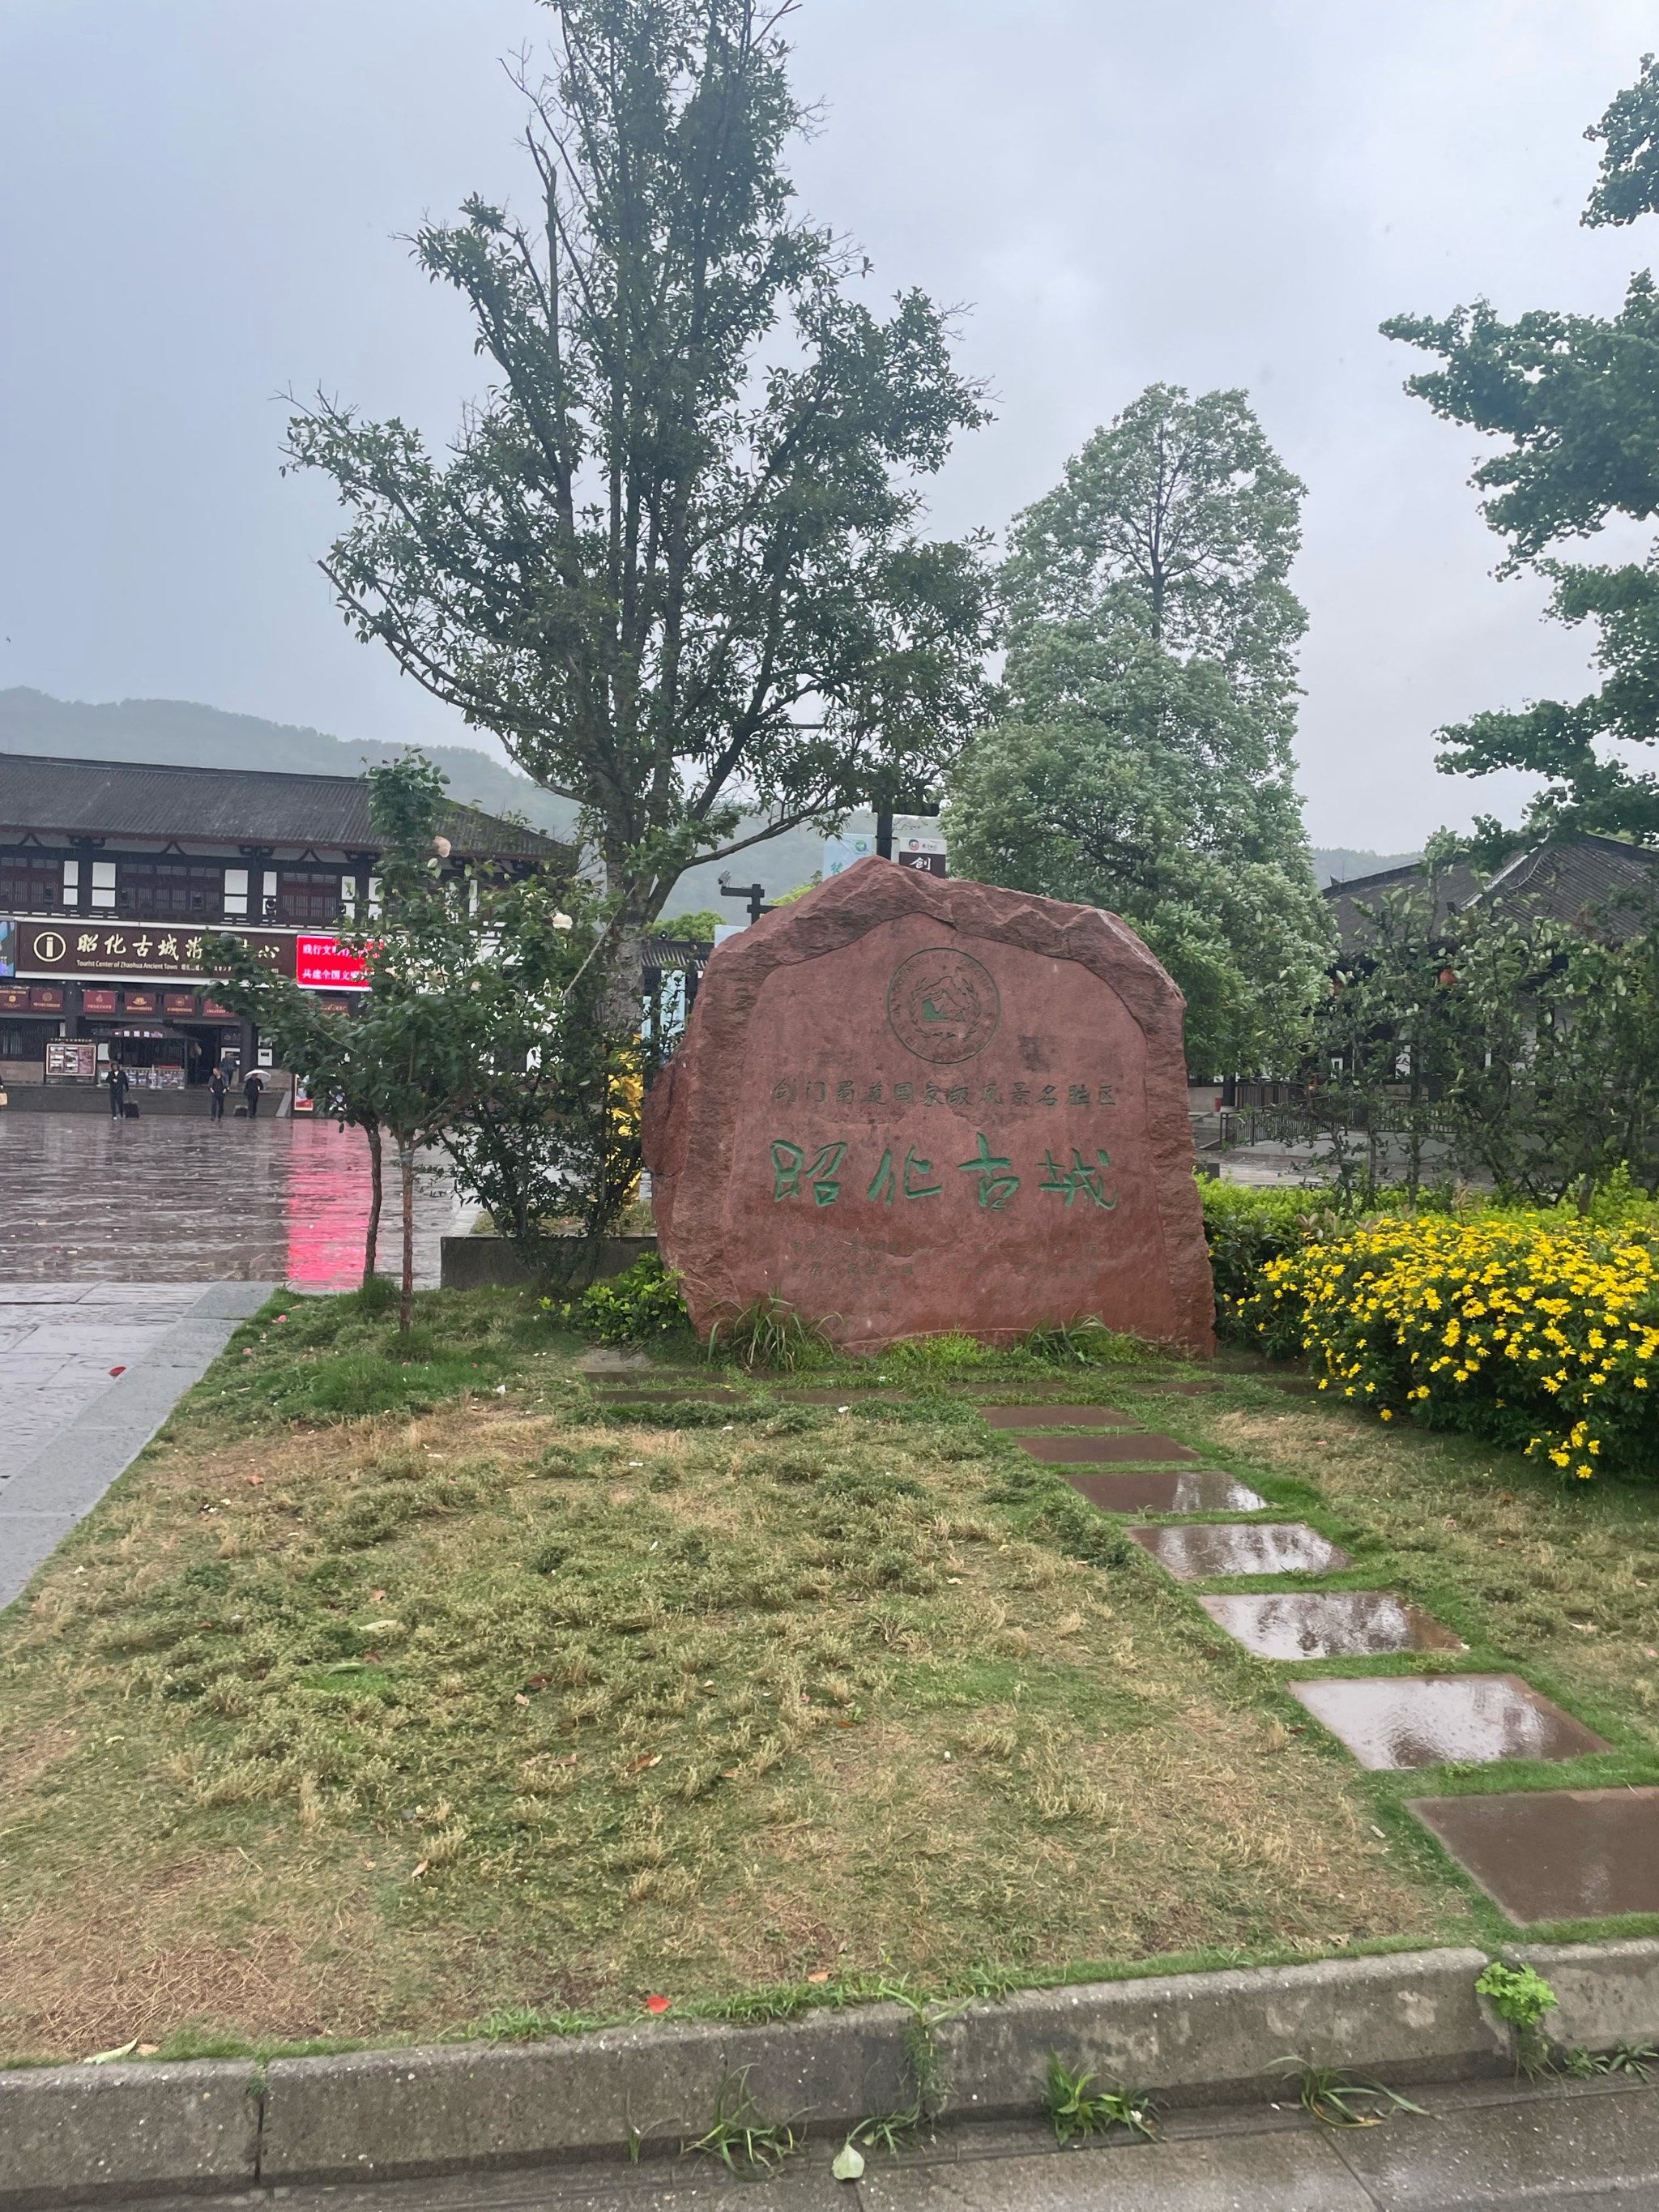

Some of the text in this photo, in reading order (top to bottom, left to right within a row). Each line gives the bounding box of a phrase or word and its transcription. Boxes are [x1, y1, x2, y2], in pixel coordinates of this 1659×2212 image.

[77, 933, 280, 962] 昭化古城游心
[77, 959, 95, 967] Tourist
[96, 960, 113, 968] Center
[120, 961, 143, 969] Zhaohua
[143, 962, 163, 970] Ancient
[164, 962, 178, 971] Town
[770, 1078, 1117, 1108] 剑门蜀道国家级风景名胜区
[770, 1133, 1120, 1211] 昭化古城
